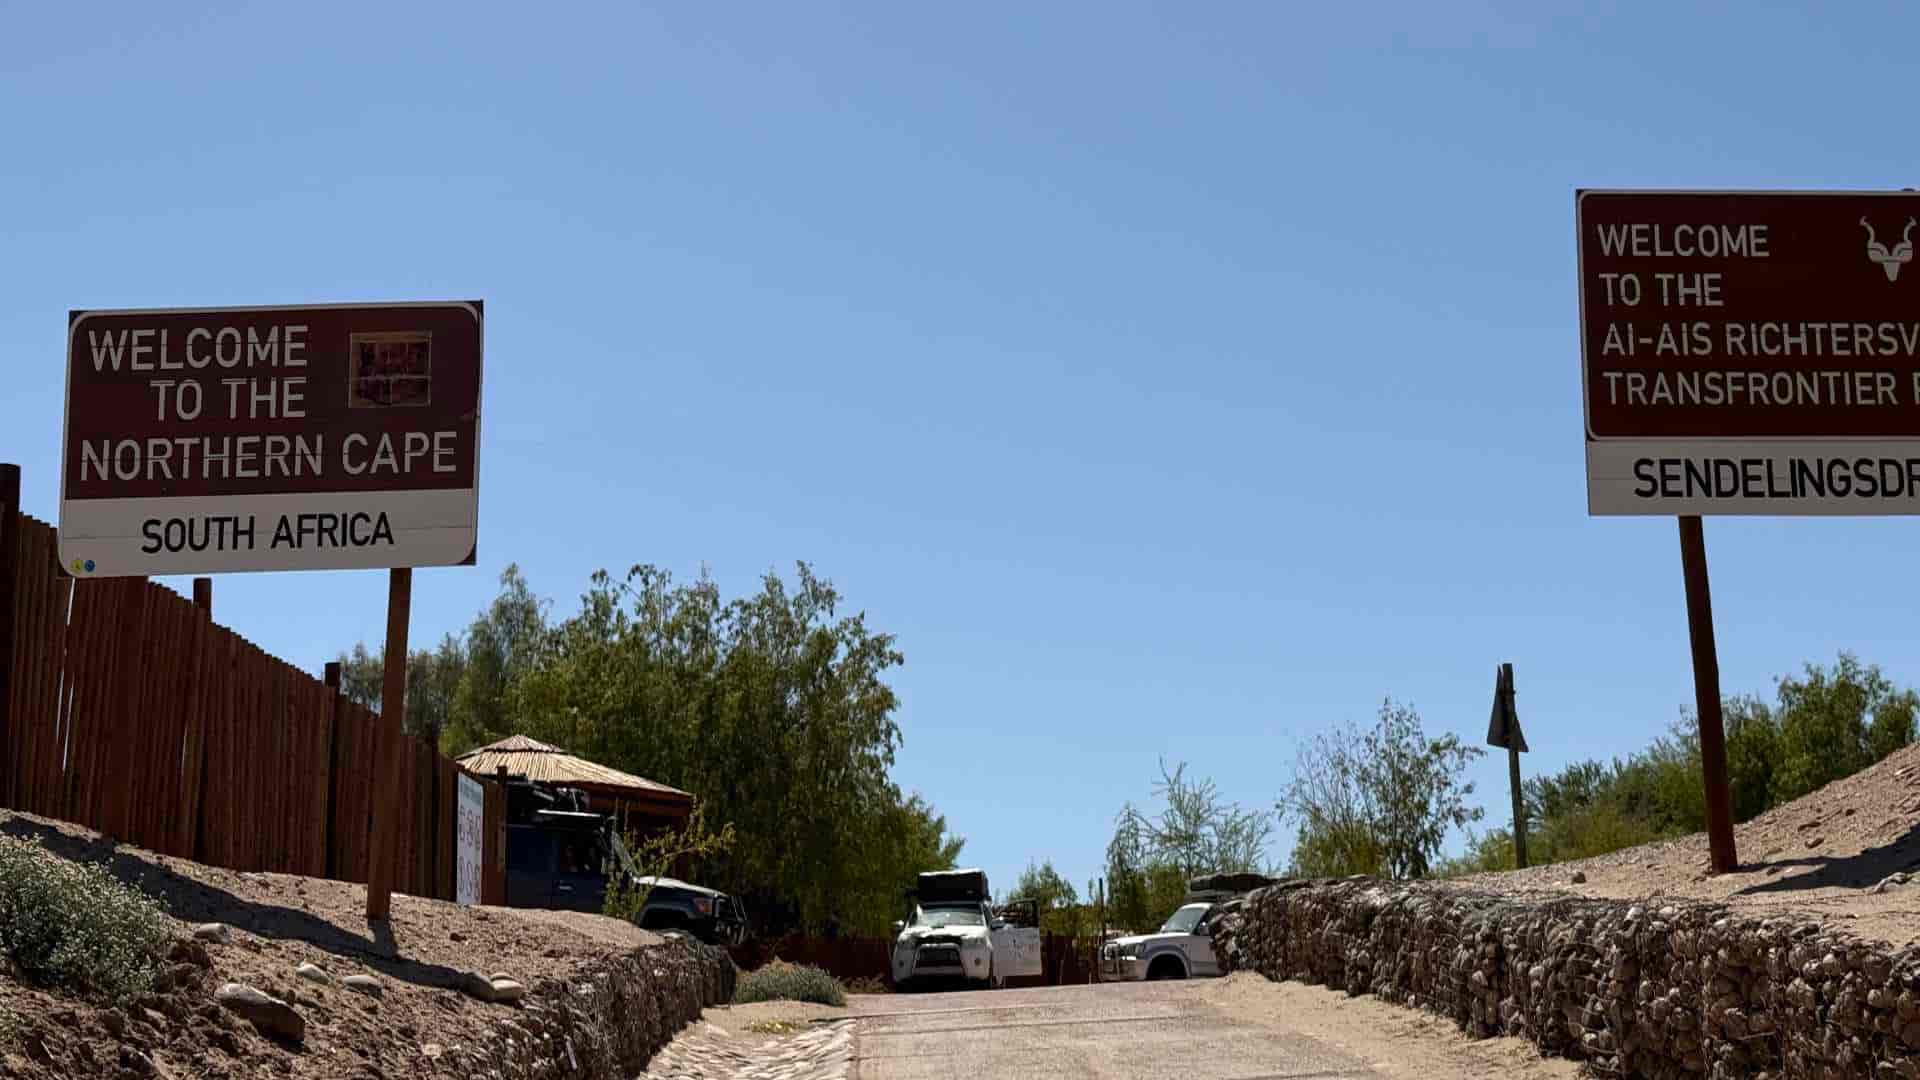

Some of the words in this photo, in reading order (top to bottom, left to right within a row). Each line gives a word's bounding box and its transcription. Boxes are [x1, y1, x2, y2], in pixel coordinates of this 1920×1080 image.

[1597, 223, 1770, 258] WELCOME
[1598, 273, 1641, 307] TO
[1654, 273, 1724, 307] THE
[88, 325, 308, 371] WELCOME
[1602, 321, 1713, 356] AI-AIS
[150, 378, 203, 421] TO
[221, 376, 307, 419] THE
[1602, 371, 1898, 405] TRANSFRONTIER
[80, 434, 323, 481] NORTHERN
[342, 431, 457, 475] CAPE
[141, 515, 255, 554] SOUTH
[270, 511, 395, 549] AFRICA
